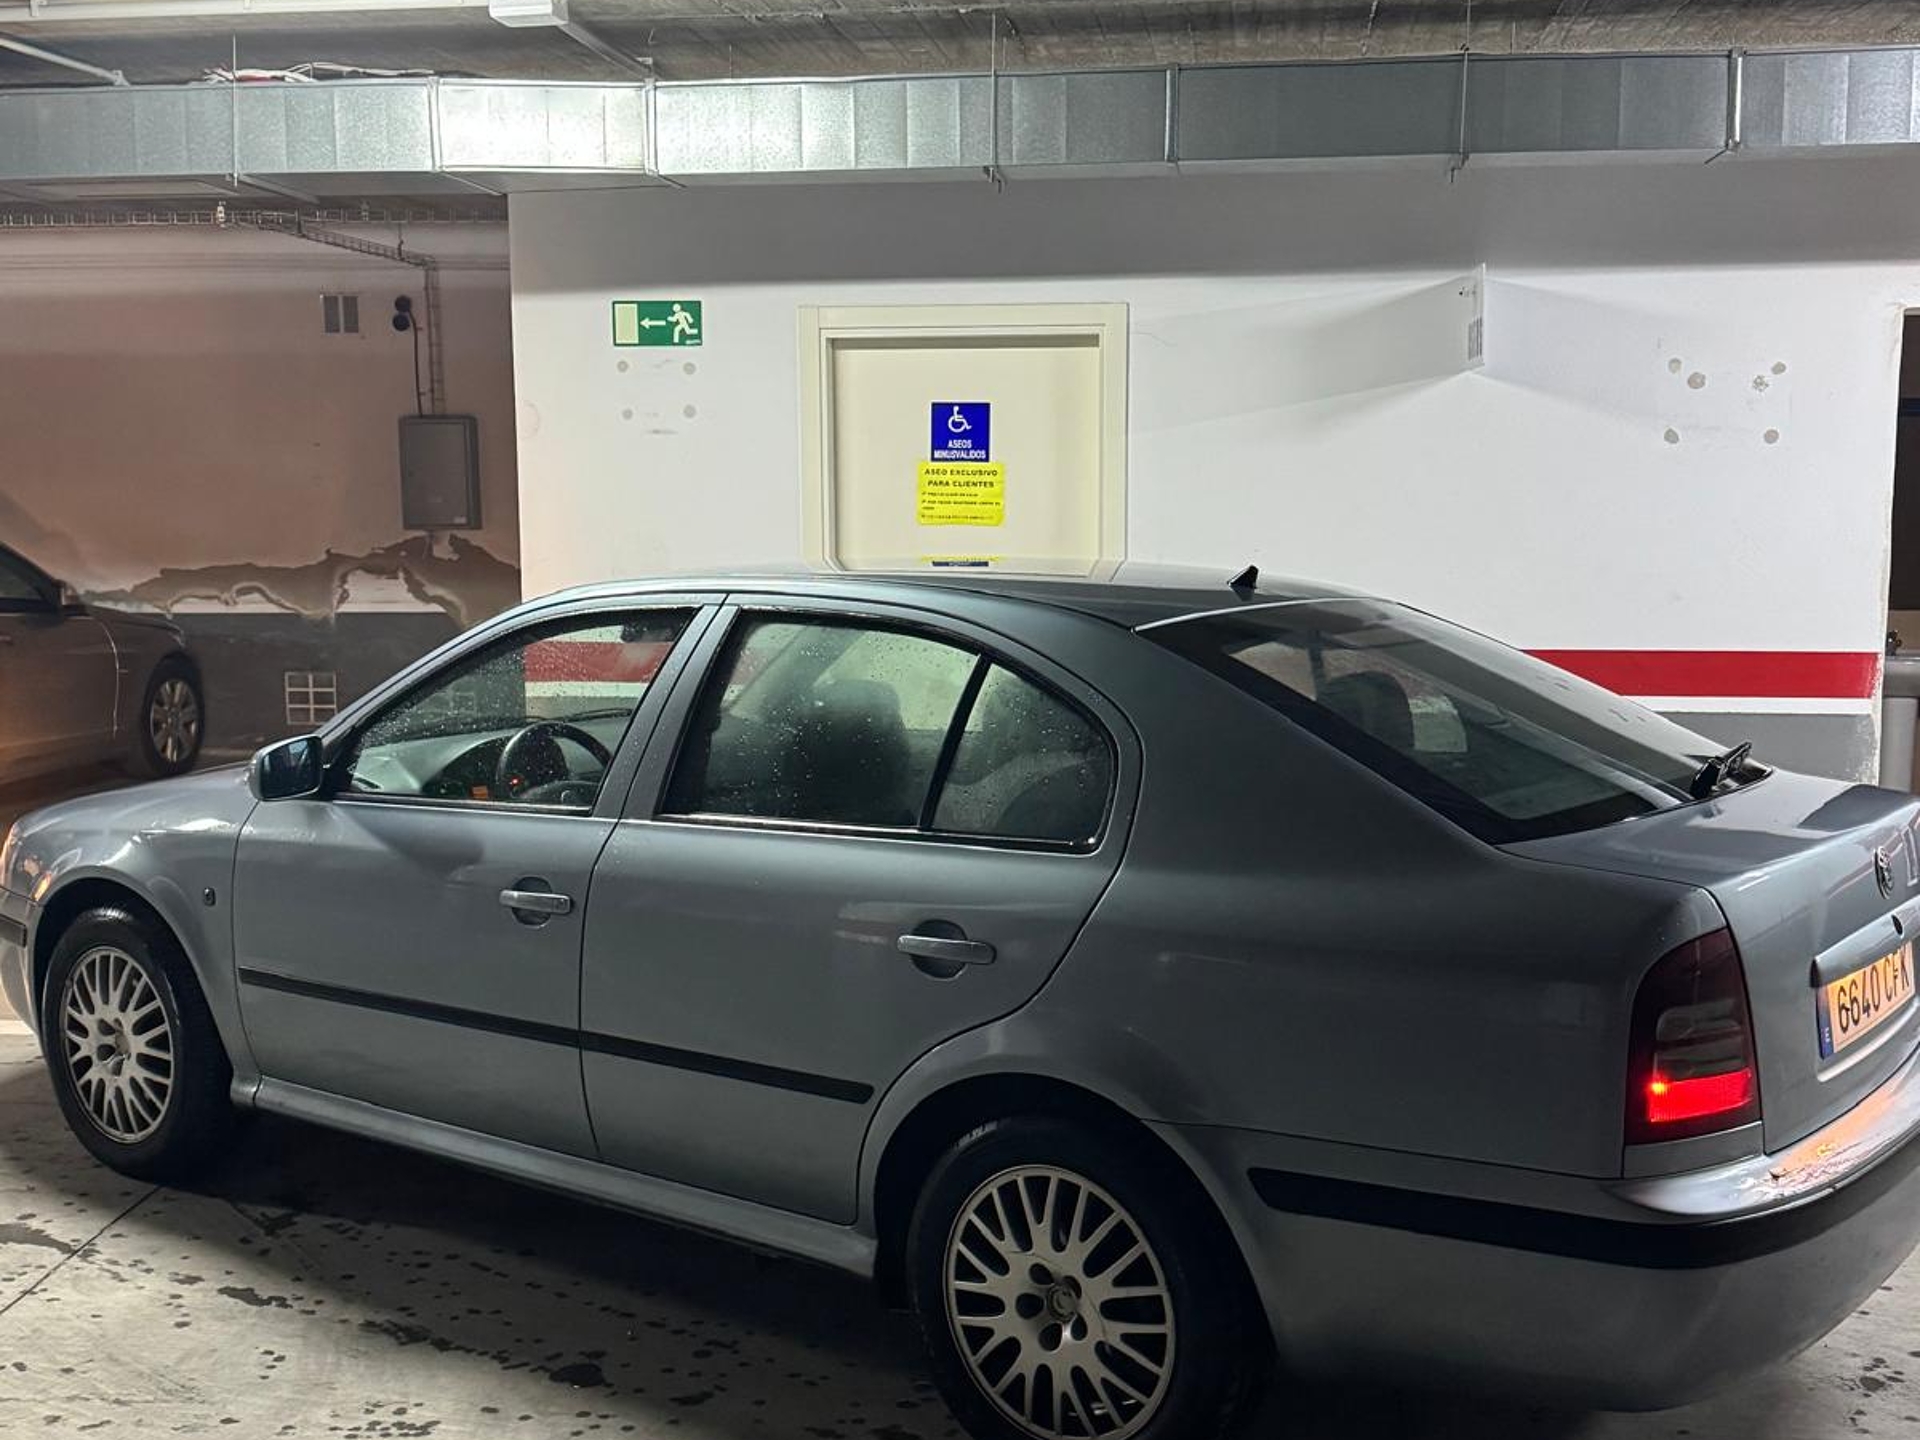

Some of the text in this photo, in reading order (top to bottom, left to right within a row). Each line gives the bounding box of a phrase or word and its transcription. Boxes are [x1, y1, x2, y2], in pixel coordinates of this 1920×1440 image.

[947, 440, 973, 449] ASEOS
[924, 468, 998, 477] ASEO EXCLUSIVO
[1837, 944, 1910, 1034] 6640 CFK
